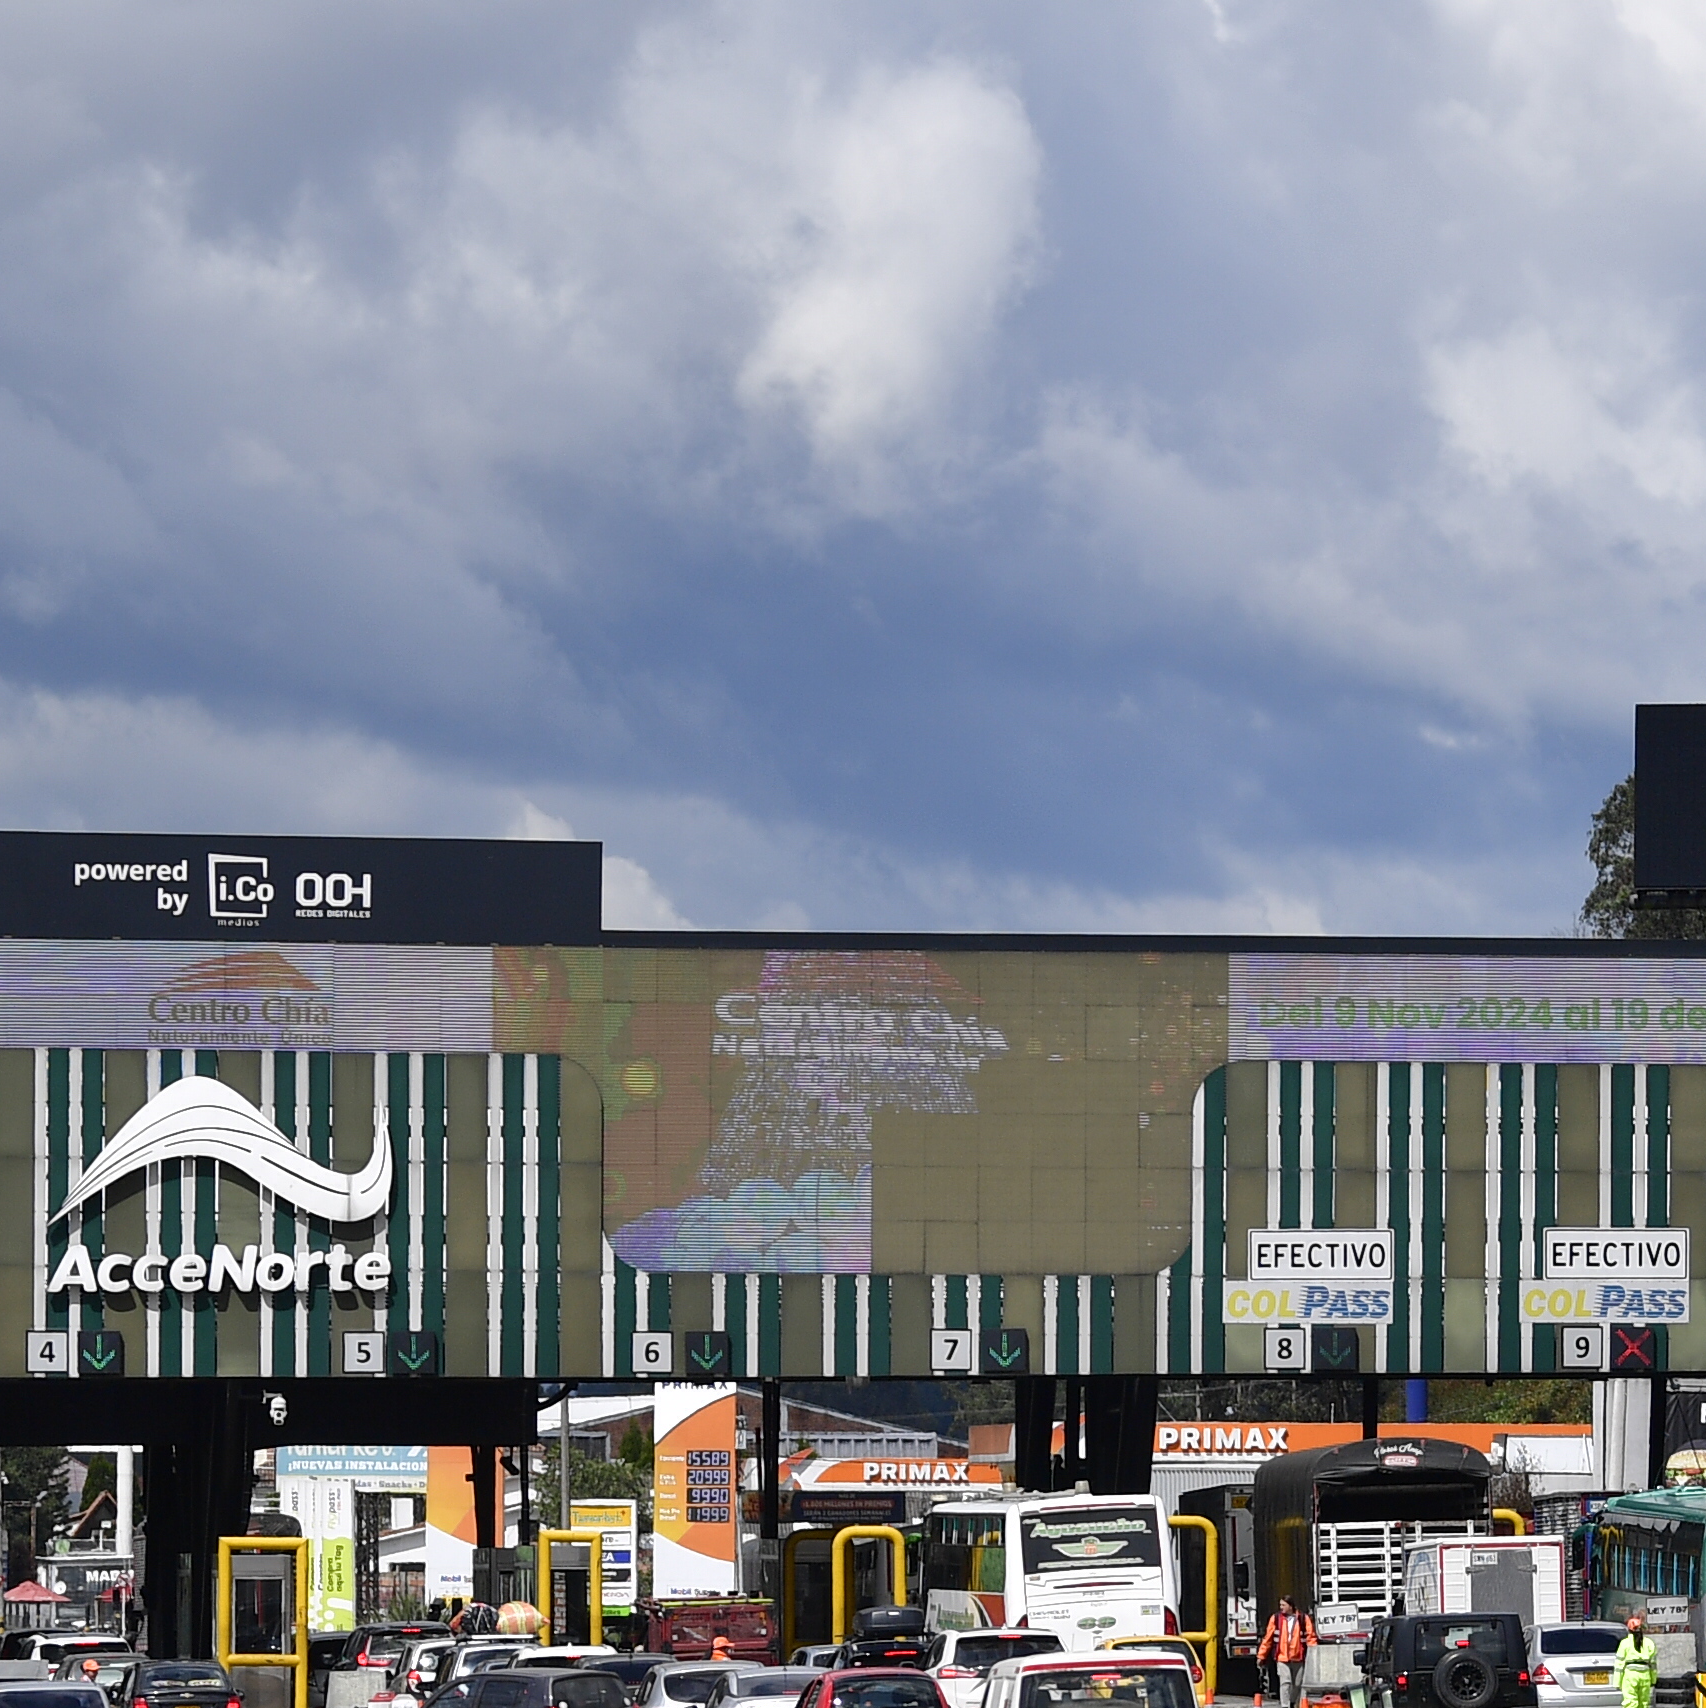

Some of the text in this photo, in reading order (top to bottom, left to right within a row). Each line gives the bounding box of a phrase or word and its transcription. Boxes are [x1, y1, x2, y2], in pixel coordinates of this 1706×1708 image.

[74, 859, 188, 886] powered
[157, 887, 189, 916] by
[217, 918, 261, 928] medios
[295, 909, 372, 919] REDES DIGITALES
[148, 994, 329, 1025] Centro Chía
[1259, 997, 1323, 1028] Del
[1338, 999, 1355, 1028] 9
[1367, 1000, 1446, 1029] Nov
[1455, 1000, 1553, 1029] 2024
[1563, 998, 1601, 1029] al
[1613, 1000, 1650, 1029] 19
[1256, 1242, 1387, 1269] EFECTIVO
[1552, 1241, 1681, 1269] EFECTIVO
[47, 1243, 392, 1293] AcceNorte
[38, 1340, 56, 1365] 4
[356, 1341, 371, 1365] 5
[645, 1340, 660, 1364] 6
[944, 1338, 959, 1361] 7
[1277, 1337, 1291, 1360] 8
[1575, 1336, 1590, 1359] 9
[1158, 1427, 1288, 1451] PRIMAX
[288, 1461, 343, 1472] ¡NUEVAS
[688, 1451, 730, 1466] 15589
[688, 1469, 730, 1485] 20999
[863, 1462, 969, 1482] PRIMAX
[692, 1488, 730, 1504] 9990
[1318, 1616, 1336, 1625] LEY
[1647, 1605, 1688, 1615] LEY 787
